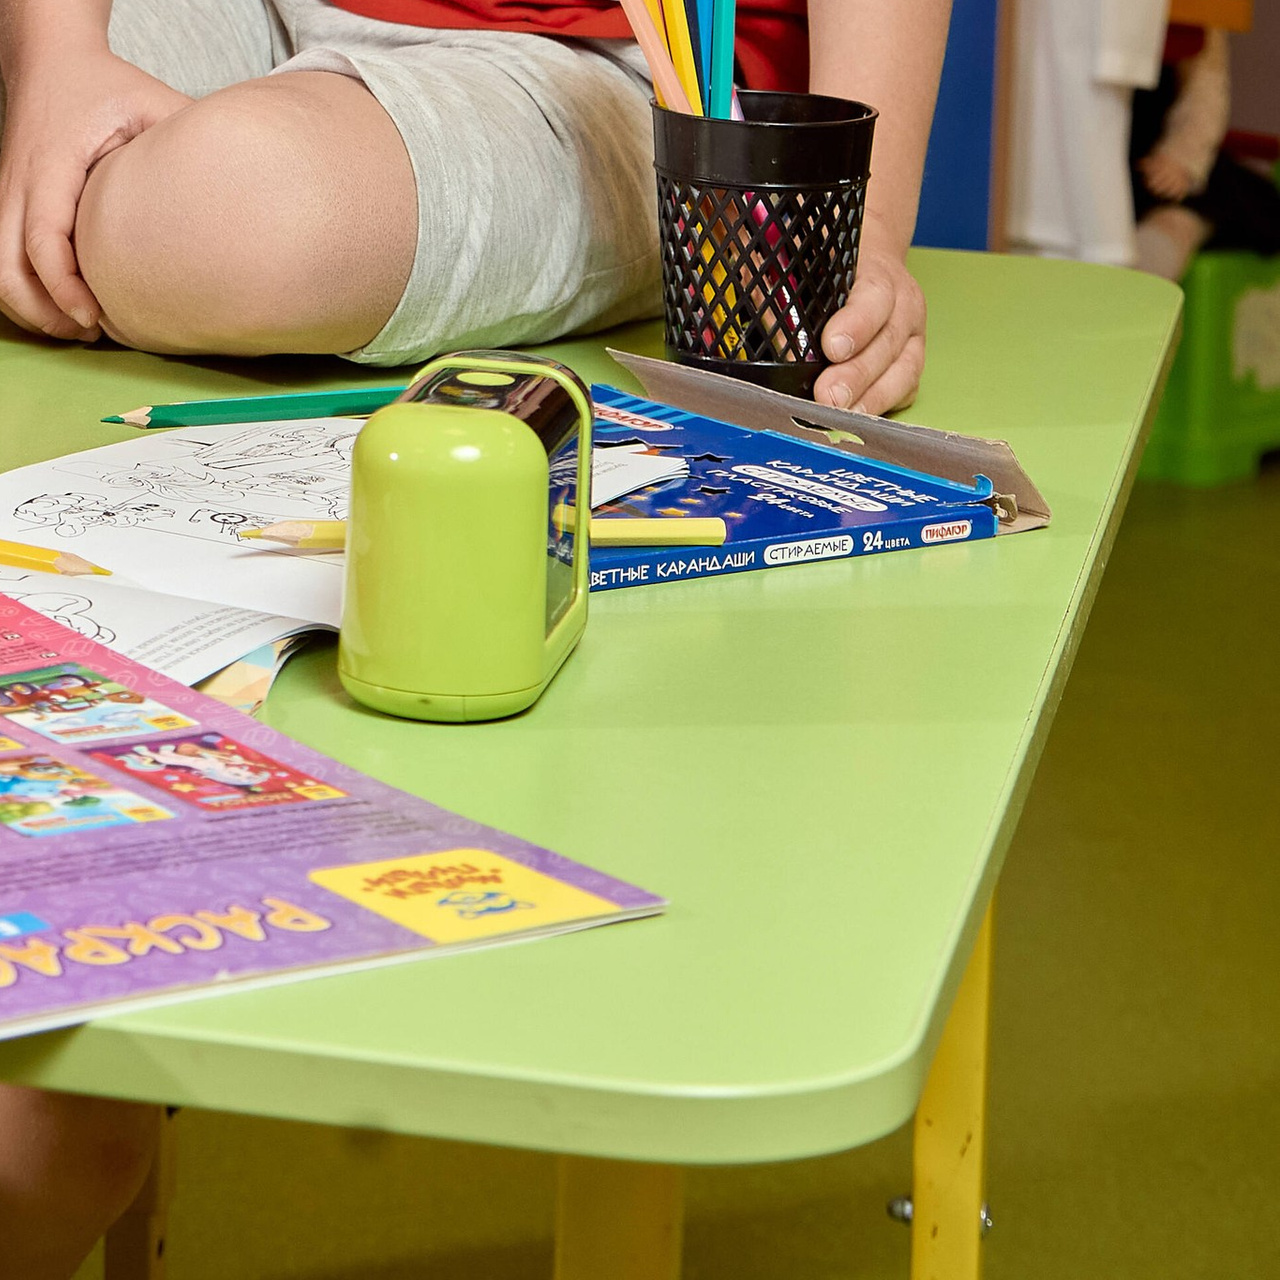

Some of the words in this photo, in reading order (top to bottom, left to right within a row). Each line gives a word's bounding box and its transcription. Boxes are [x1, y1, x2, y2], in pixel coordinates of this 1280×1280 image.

[706, 469, 853, 515] ПЛАСТИКОВЫЕ
[766, 460, 916, 507] КАРАНДАШИ
[829, 469, 939, 504] ЦВЕТНЫЕ
[588, 564, 650, 588] ВЕТНЫЕ
[657, 550, 755, 578] КАРАНДАШИ
[769, 539, 849, 560] СТИРАЕМЫЕ
[862, 530, 883, 552] 24
[884, 537, 911, 550] ЦВЕТА
[925, 523, 968, 539] ПИФАГОР
